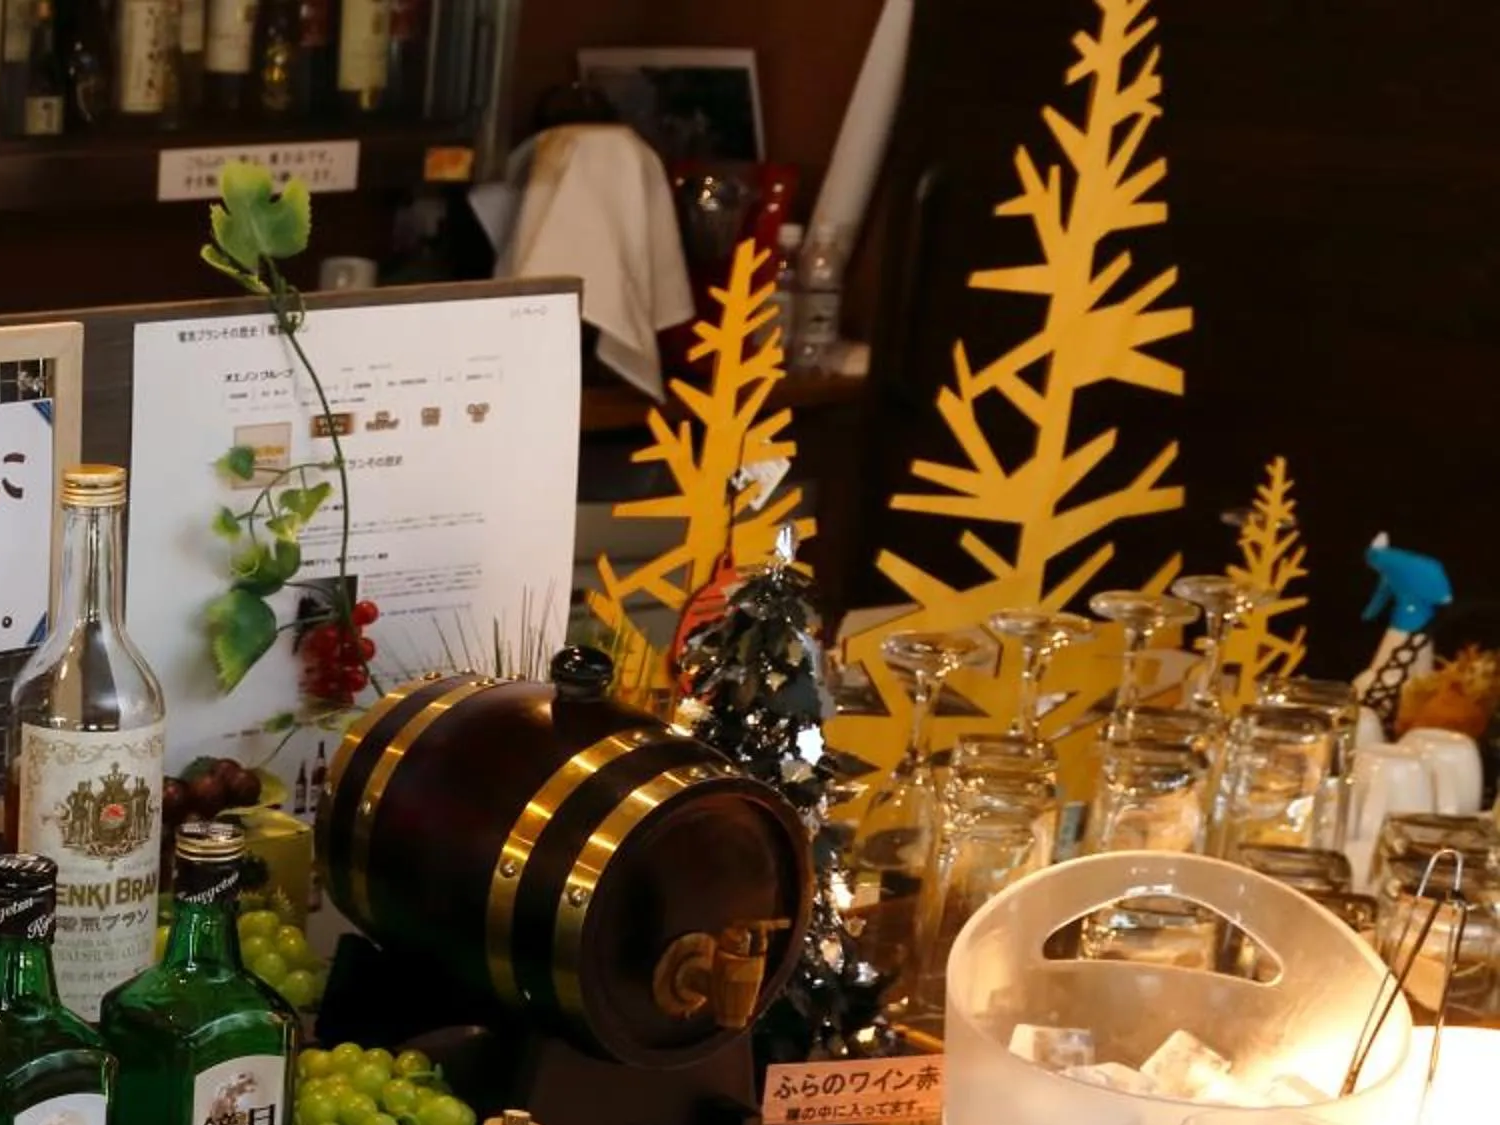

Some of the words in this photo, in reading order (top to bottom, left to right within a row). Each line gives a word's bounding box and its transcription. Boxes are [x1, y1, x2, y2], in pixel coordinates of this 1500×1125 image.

[56, 882, 112, 911] ENKI
[774, 1066, 939, 1100] ふらのワイン赤
